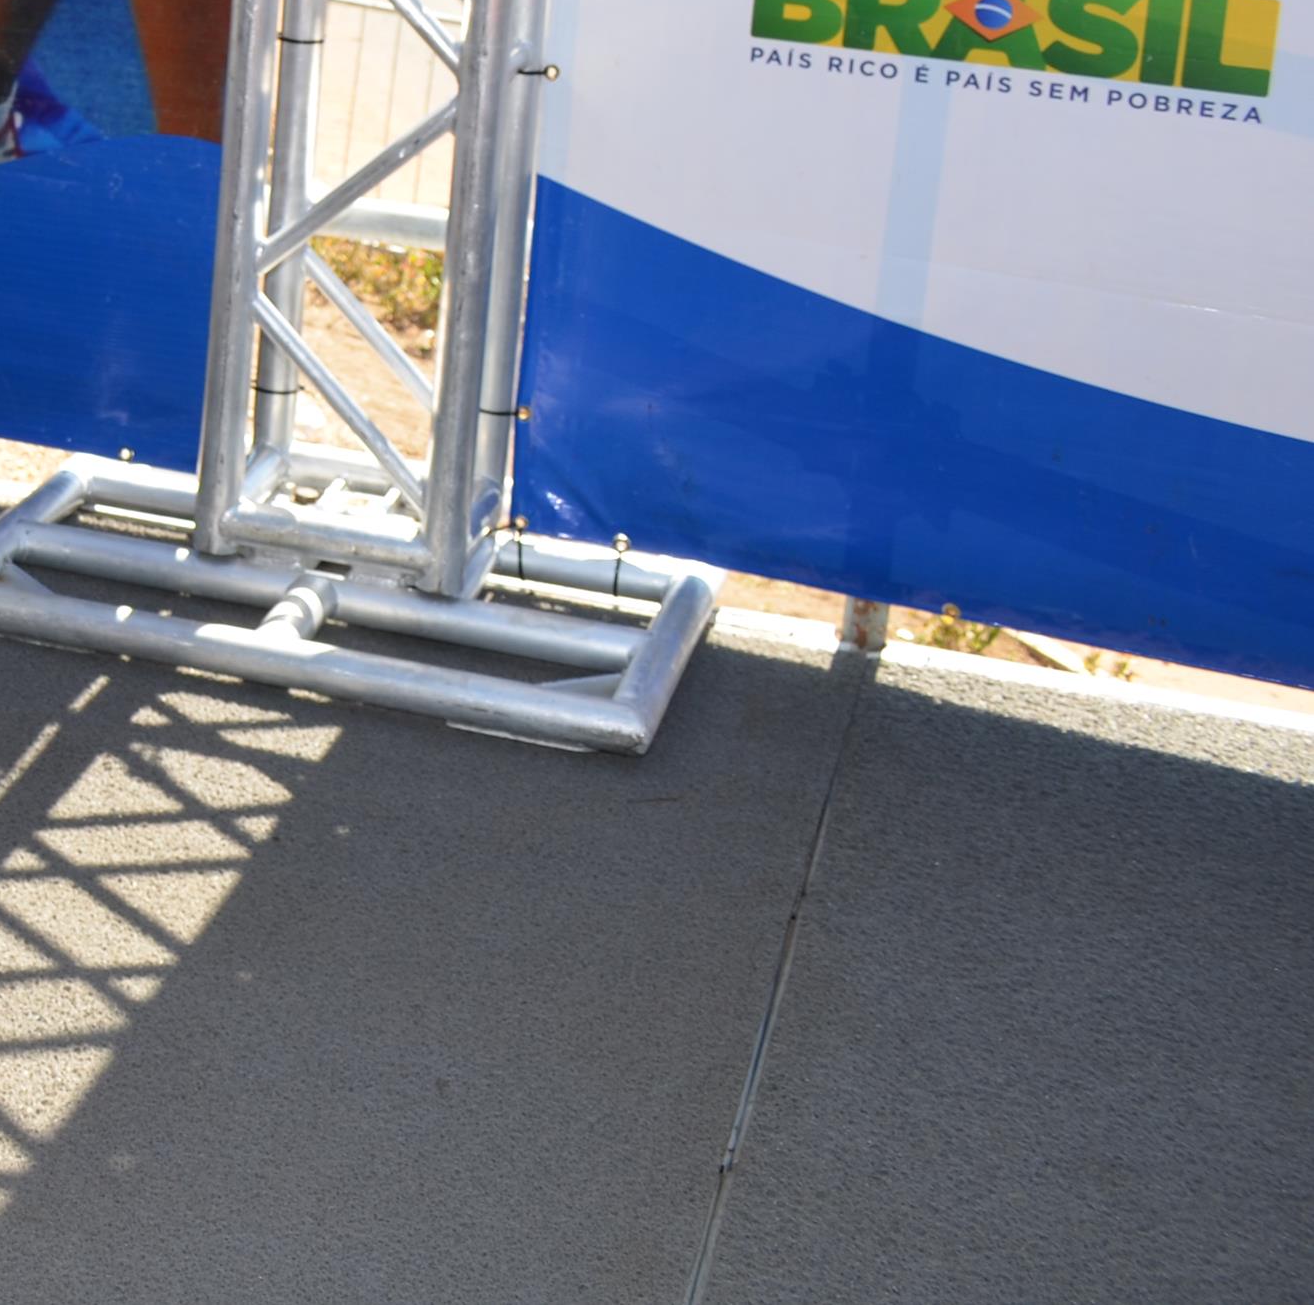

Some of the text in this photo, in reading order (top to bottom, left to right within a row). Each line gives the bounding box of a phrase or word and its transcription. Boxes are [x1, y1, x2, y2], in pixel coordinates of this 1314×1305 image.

[750, 47, 1262, 125] PAÍS RICO É PAÍS SEM POBREZA
